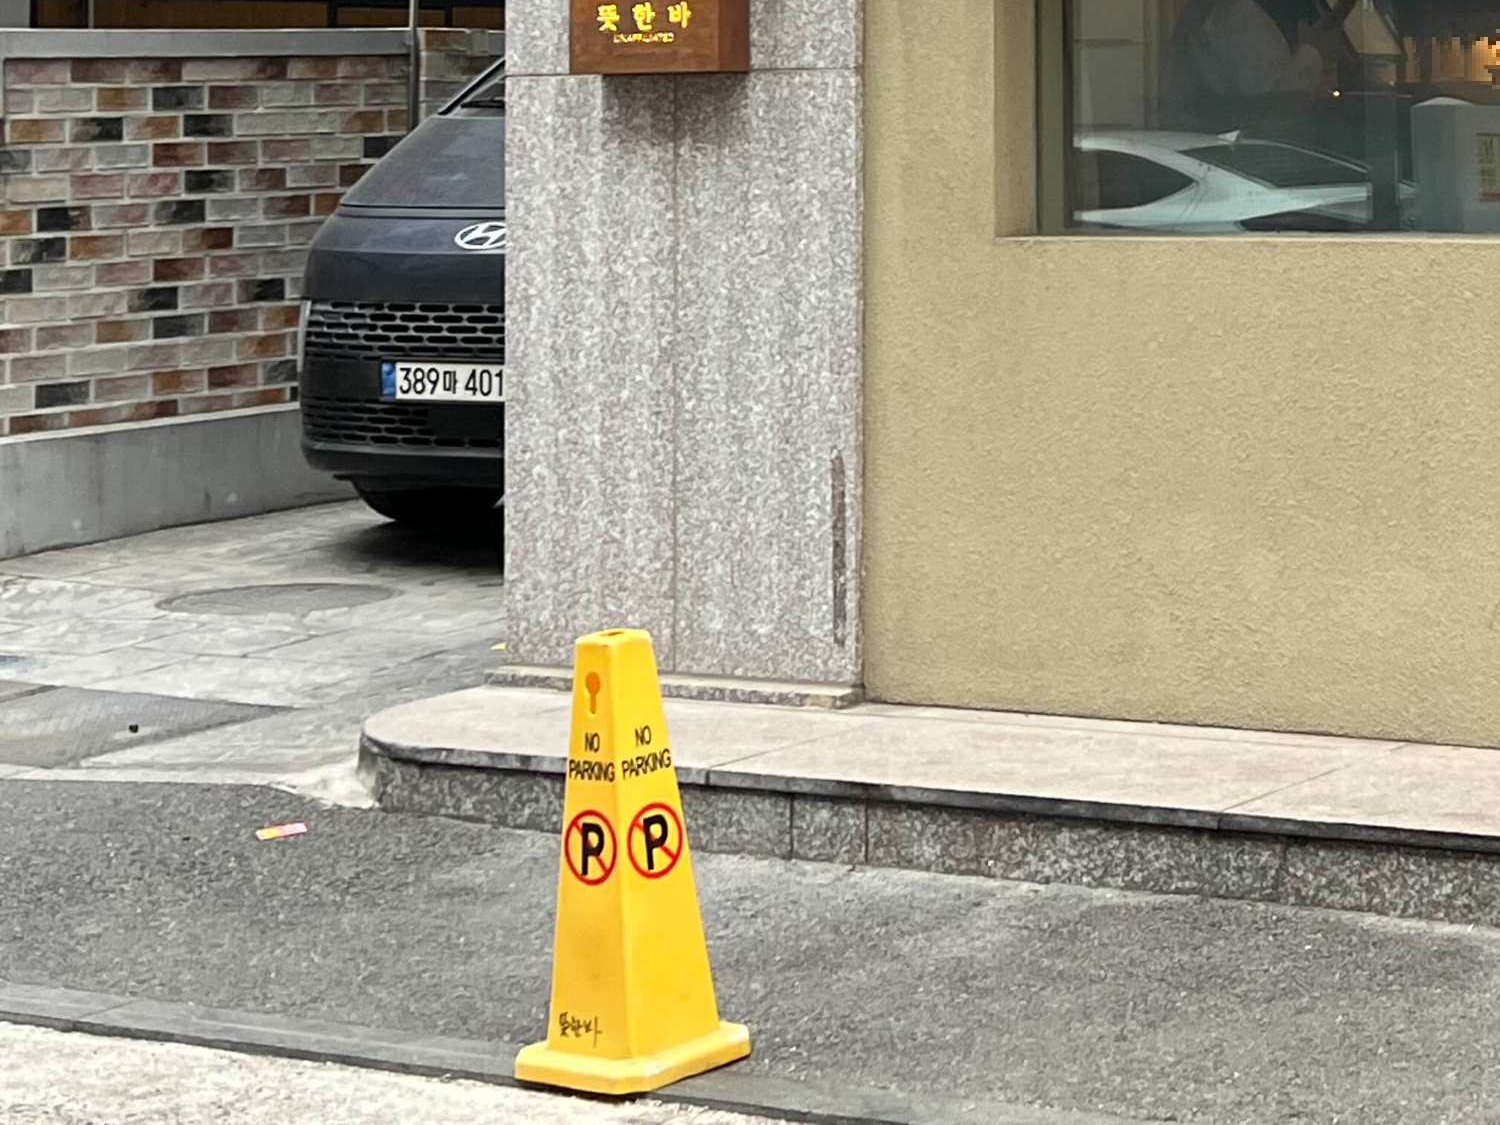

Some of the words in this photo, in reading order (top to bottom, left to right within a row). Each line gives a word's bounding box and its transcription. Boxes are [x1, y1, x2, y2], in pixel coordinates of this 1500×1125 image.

[399, 367, 457, 395] 389마
[464, 369, 504, 397] 401
[584, 732, 600, 752] NO
[635, 725, 652, 748] NO
[569, 759, 615, 782] PARKING
[621, 748, 672, 780] PARKING
